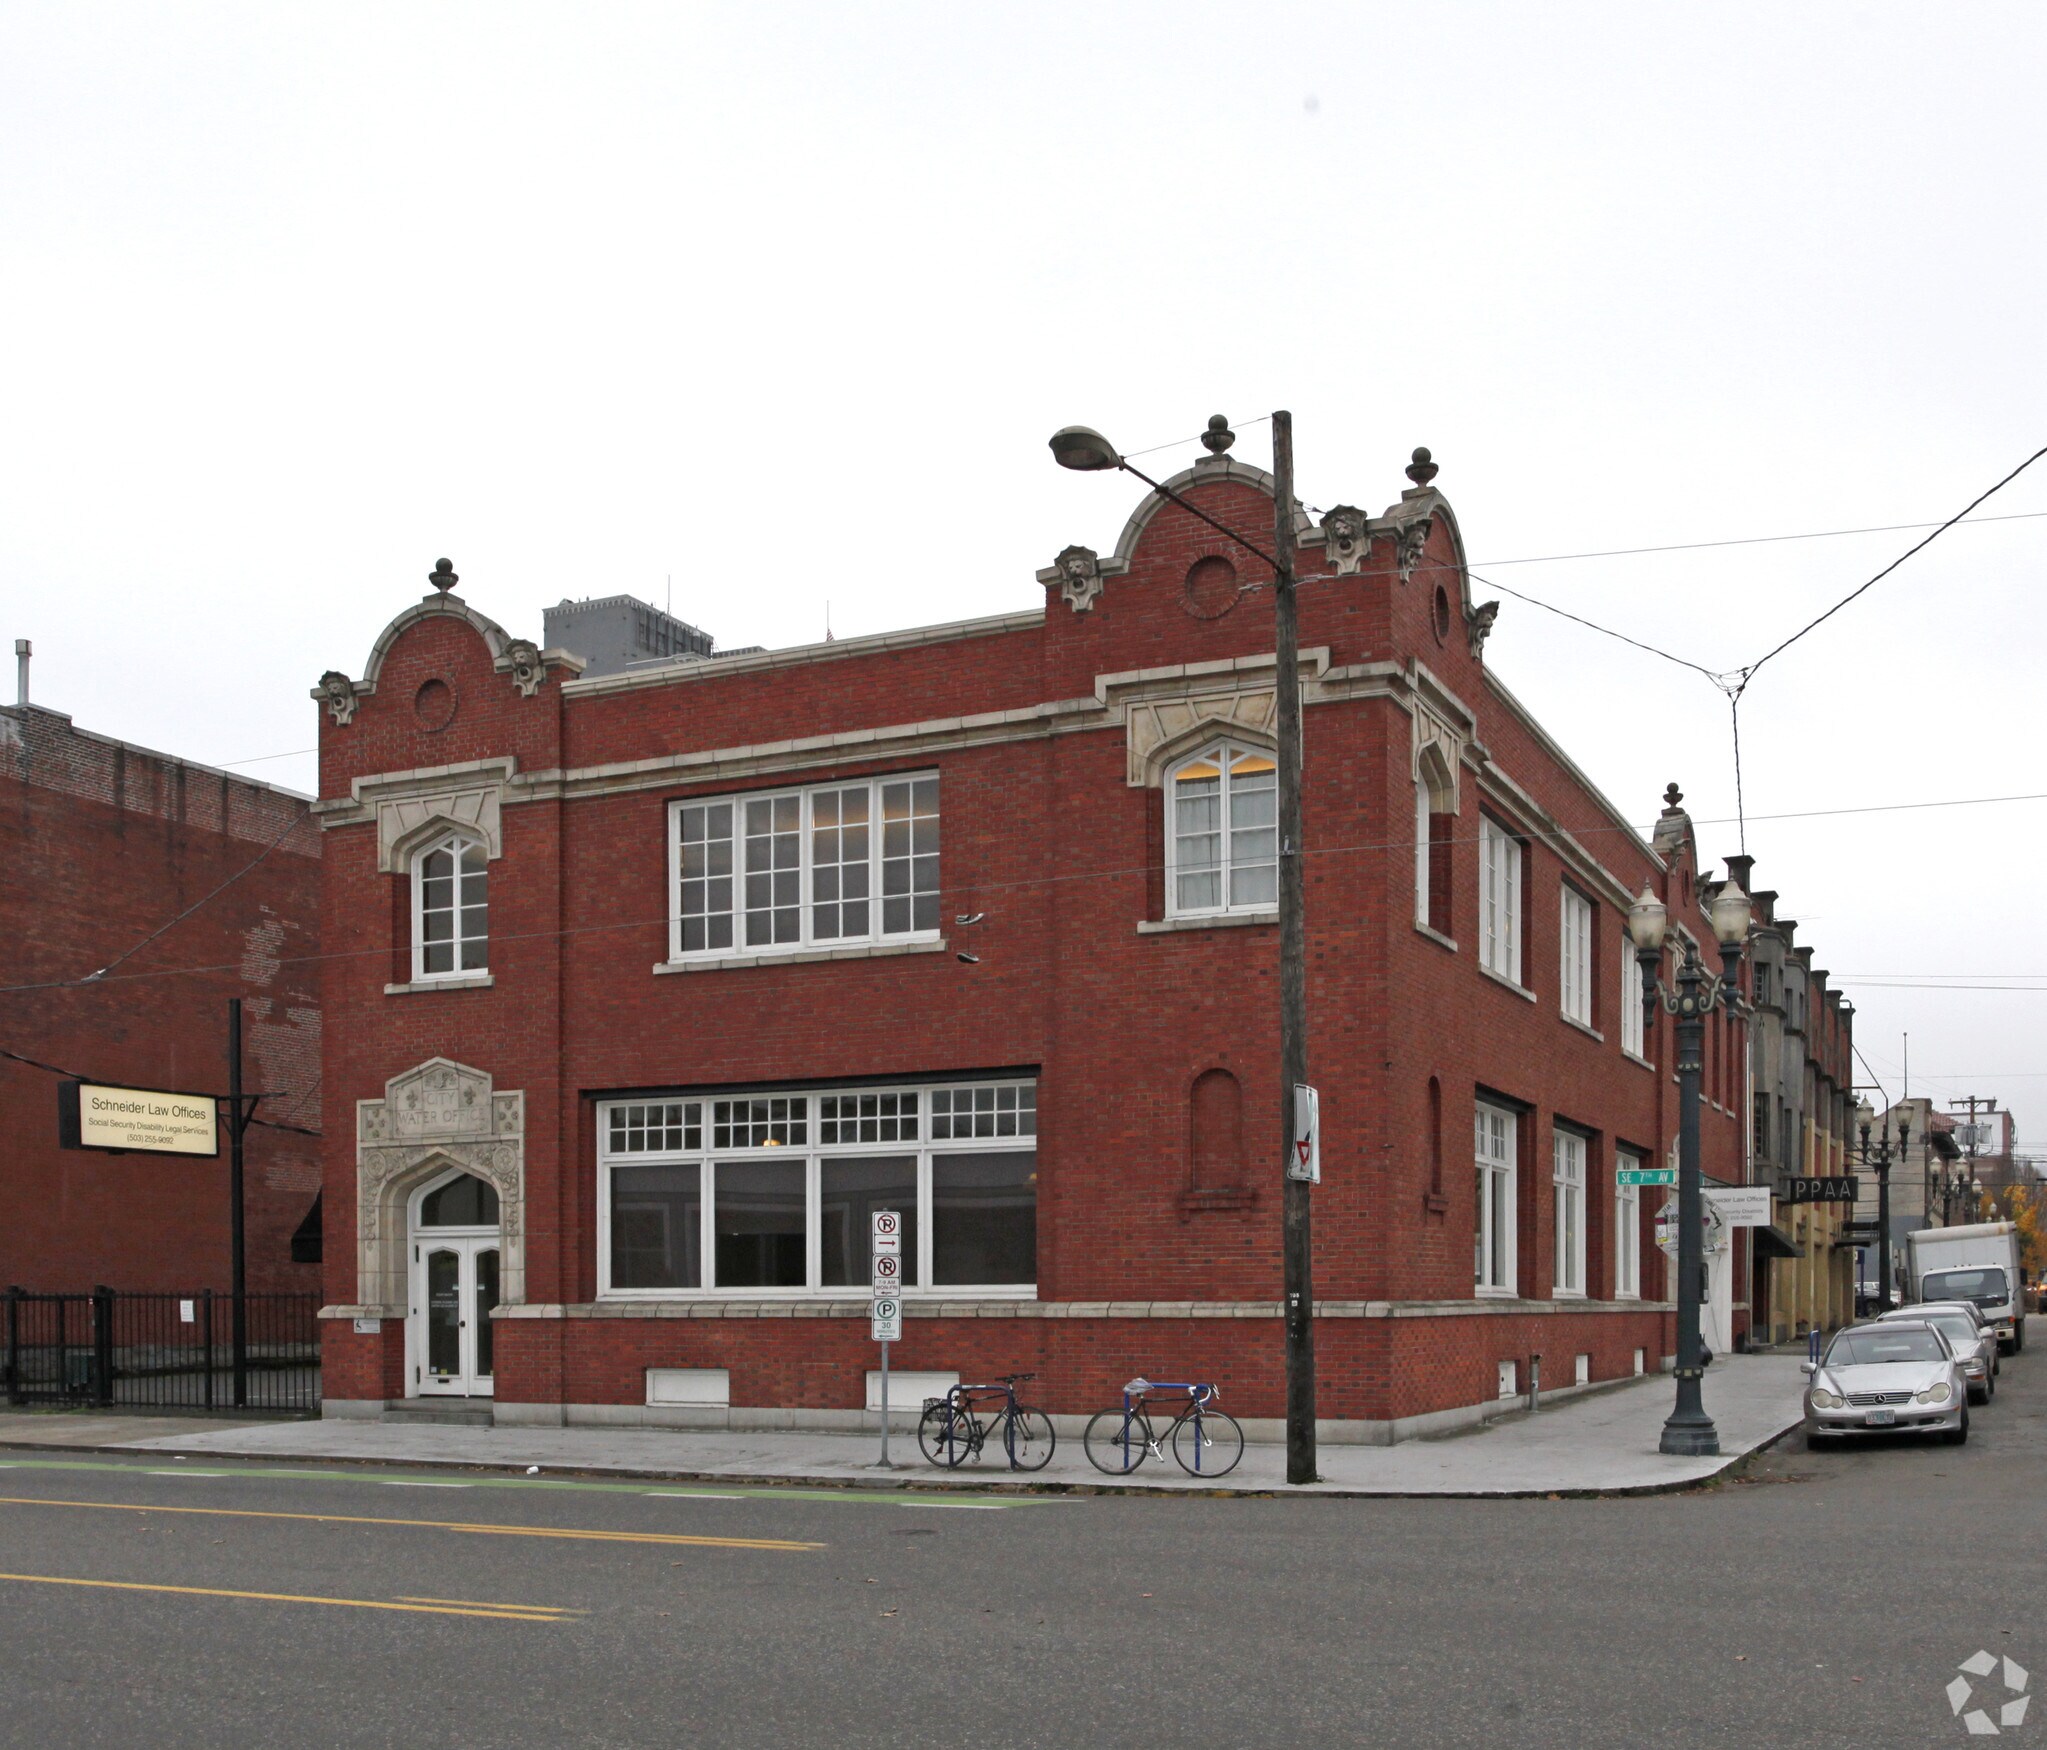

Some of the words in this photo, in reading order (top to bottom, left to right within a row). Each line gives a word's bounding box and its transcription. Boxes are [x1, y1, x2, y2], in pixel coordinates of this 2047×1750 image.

[427, 1092, 455, 1105] CITY
[91, 1097, 145, 1114] Schneider
[148, 1103, 169, 1116] Law
[172, 1105, 206, 1120] Offices
[398, 1110, 437, 1125] WATER
[443, 1108, 486, 1122] OFFICE
[88, 1117, 109, 1127] Social
[109, 1119, 136, 1131] Security
[136, 1122, 165, 1133] Disability
[165, 1124, 182, 1135] Legal
[182, 1126, 209, 1136] Services
[127, 1134, 144, 1143] (503)
[1621, 1172, 1632, 1183] SE
[1658, 1171, 1669, 1183] AV
[1796, 1180, 1851, 1198] PPAA
[883, 1304, 892, 1315] P
